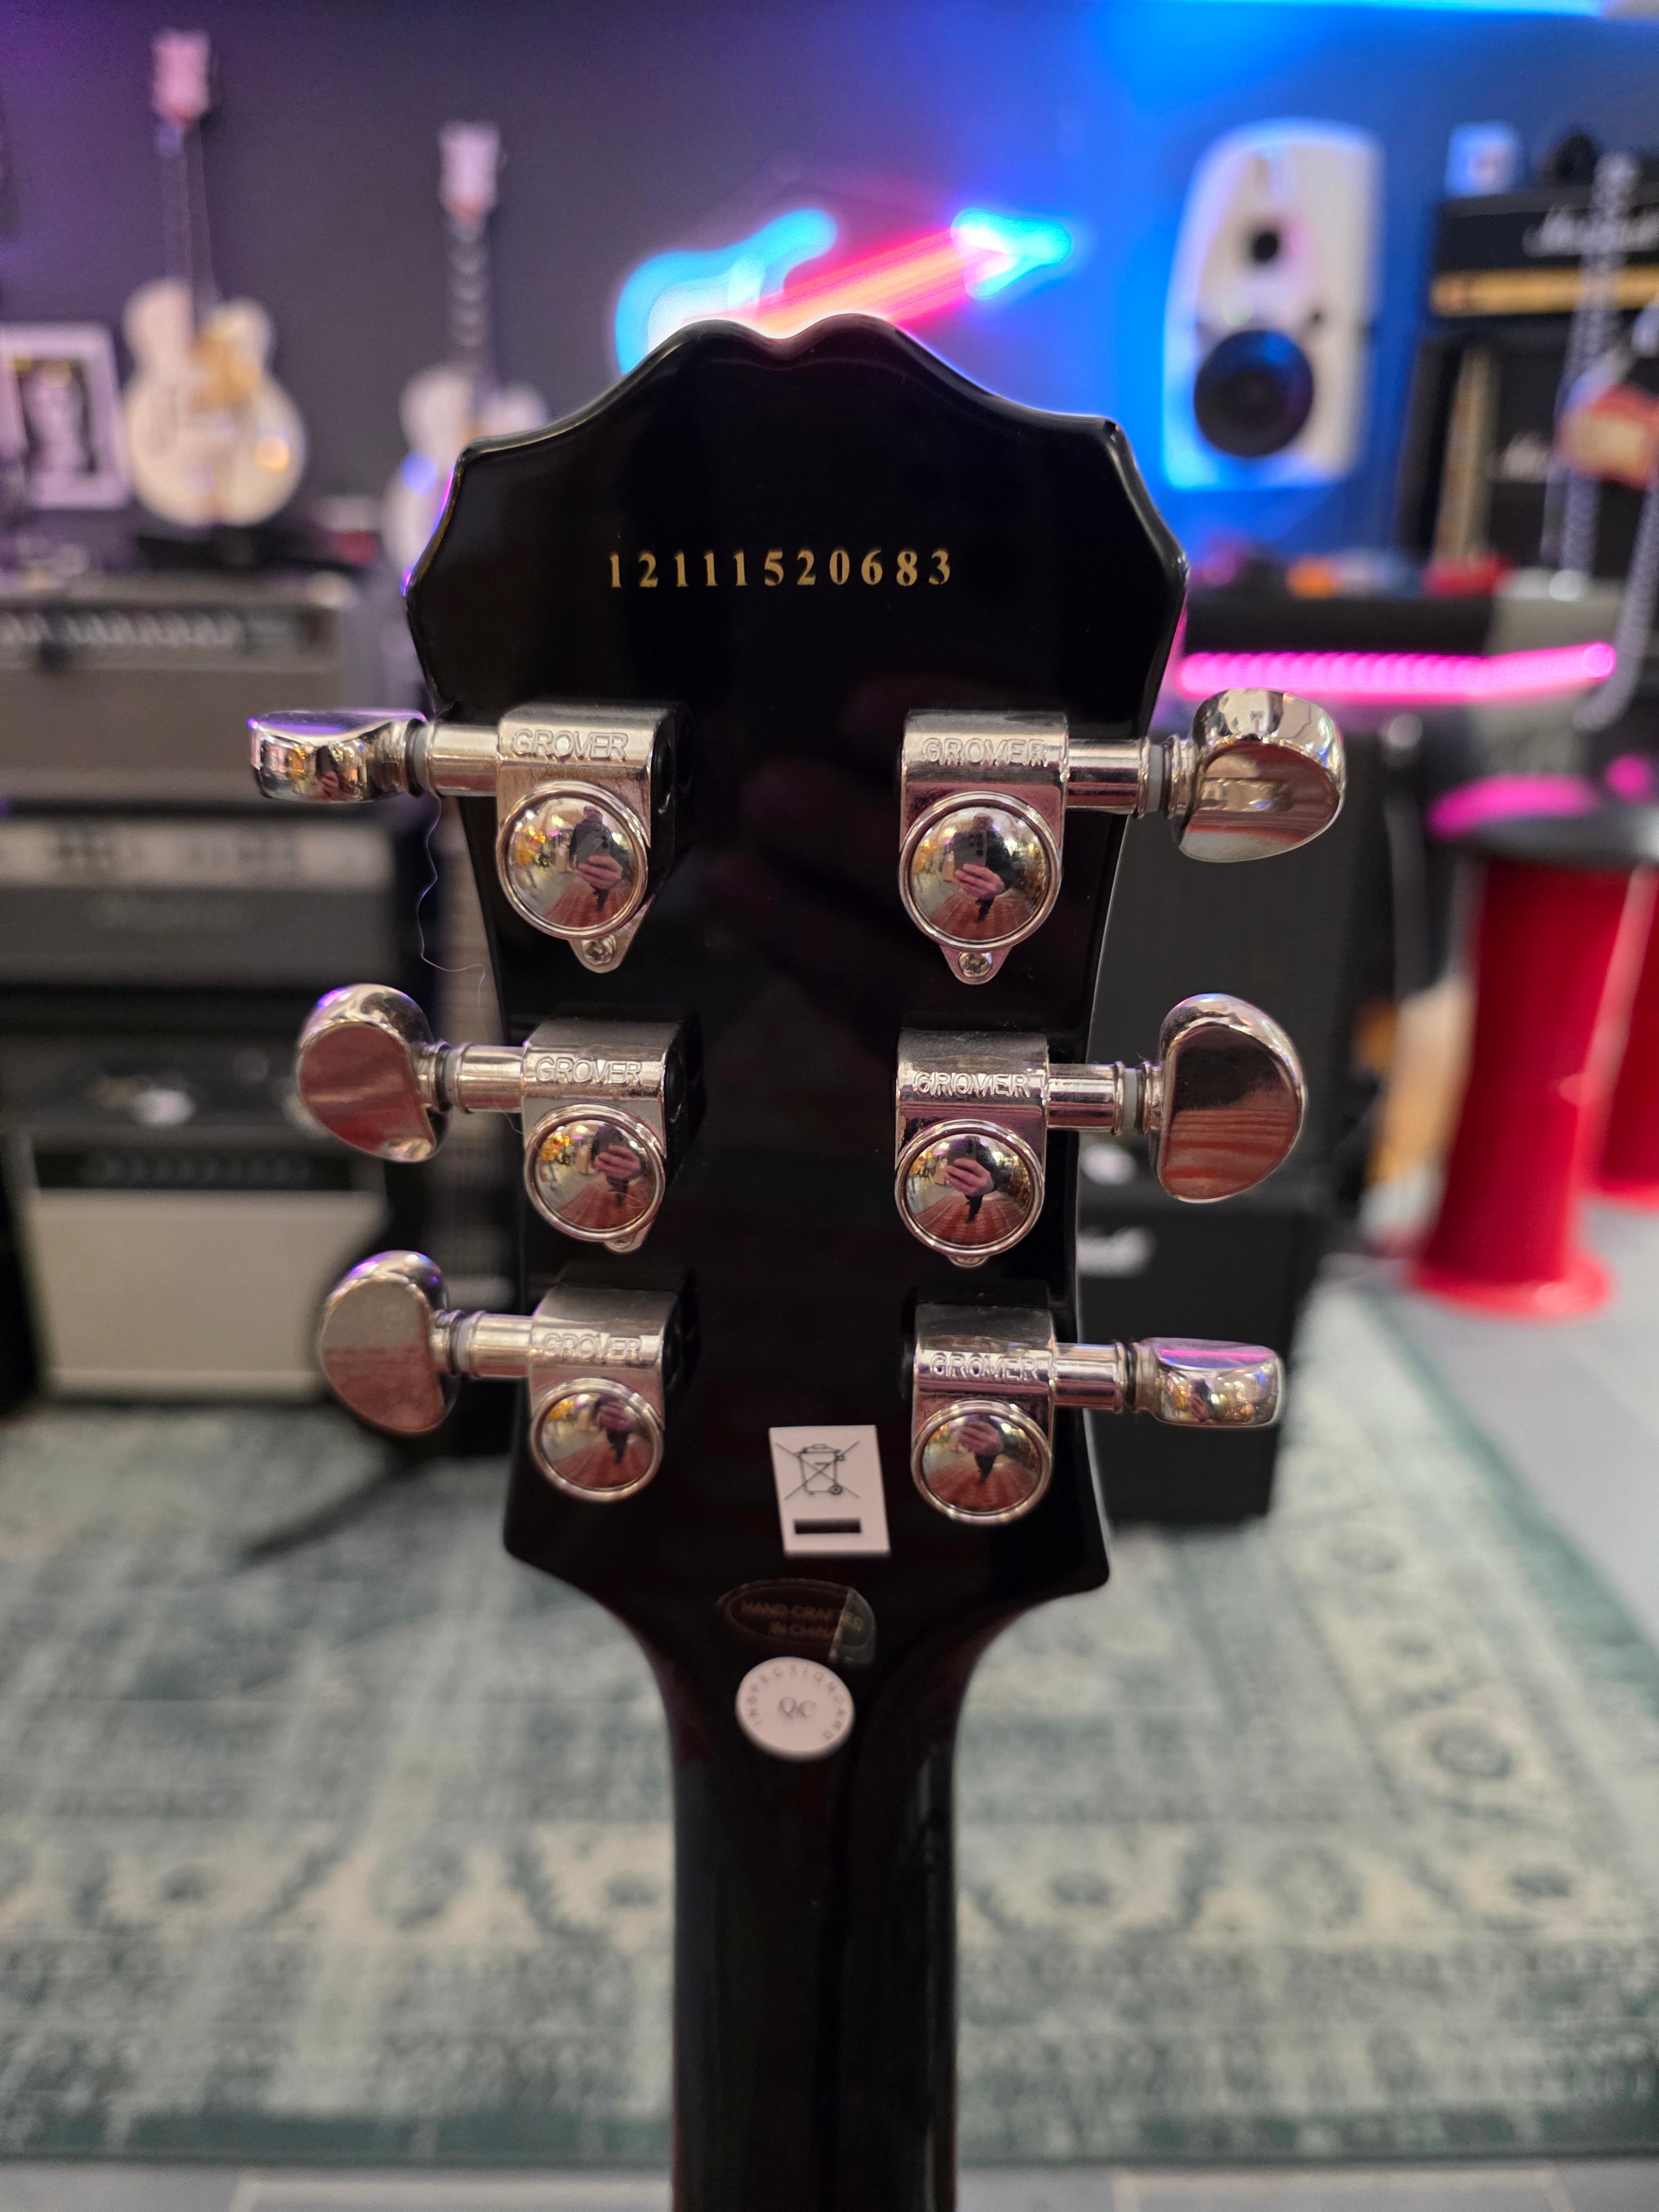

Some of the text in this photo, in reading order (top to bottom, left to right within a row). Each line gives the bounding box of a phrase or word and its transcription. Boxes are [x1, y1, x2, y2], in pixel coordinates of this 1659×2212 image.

[609, 548, 951, 588] 12111520683
[511, 729, 629, 761] GROVER
[921, 738, 1048, 766] GROVER
[536, 1056, 643, 1084] GROVER
[913, 1071, 1030, 1098] GROVER
[544, 1332, 643, 1363] GROVER
[930, 1352, 1039, 1381] GROVER
[778, 1697, 816, 1720] QC
